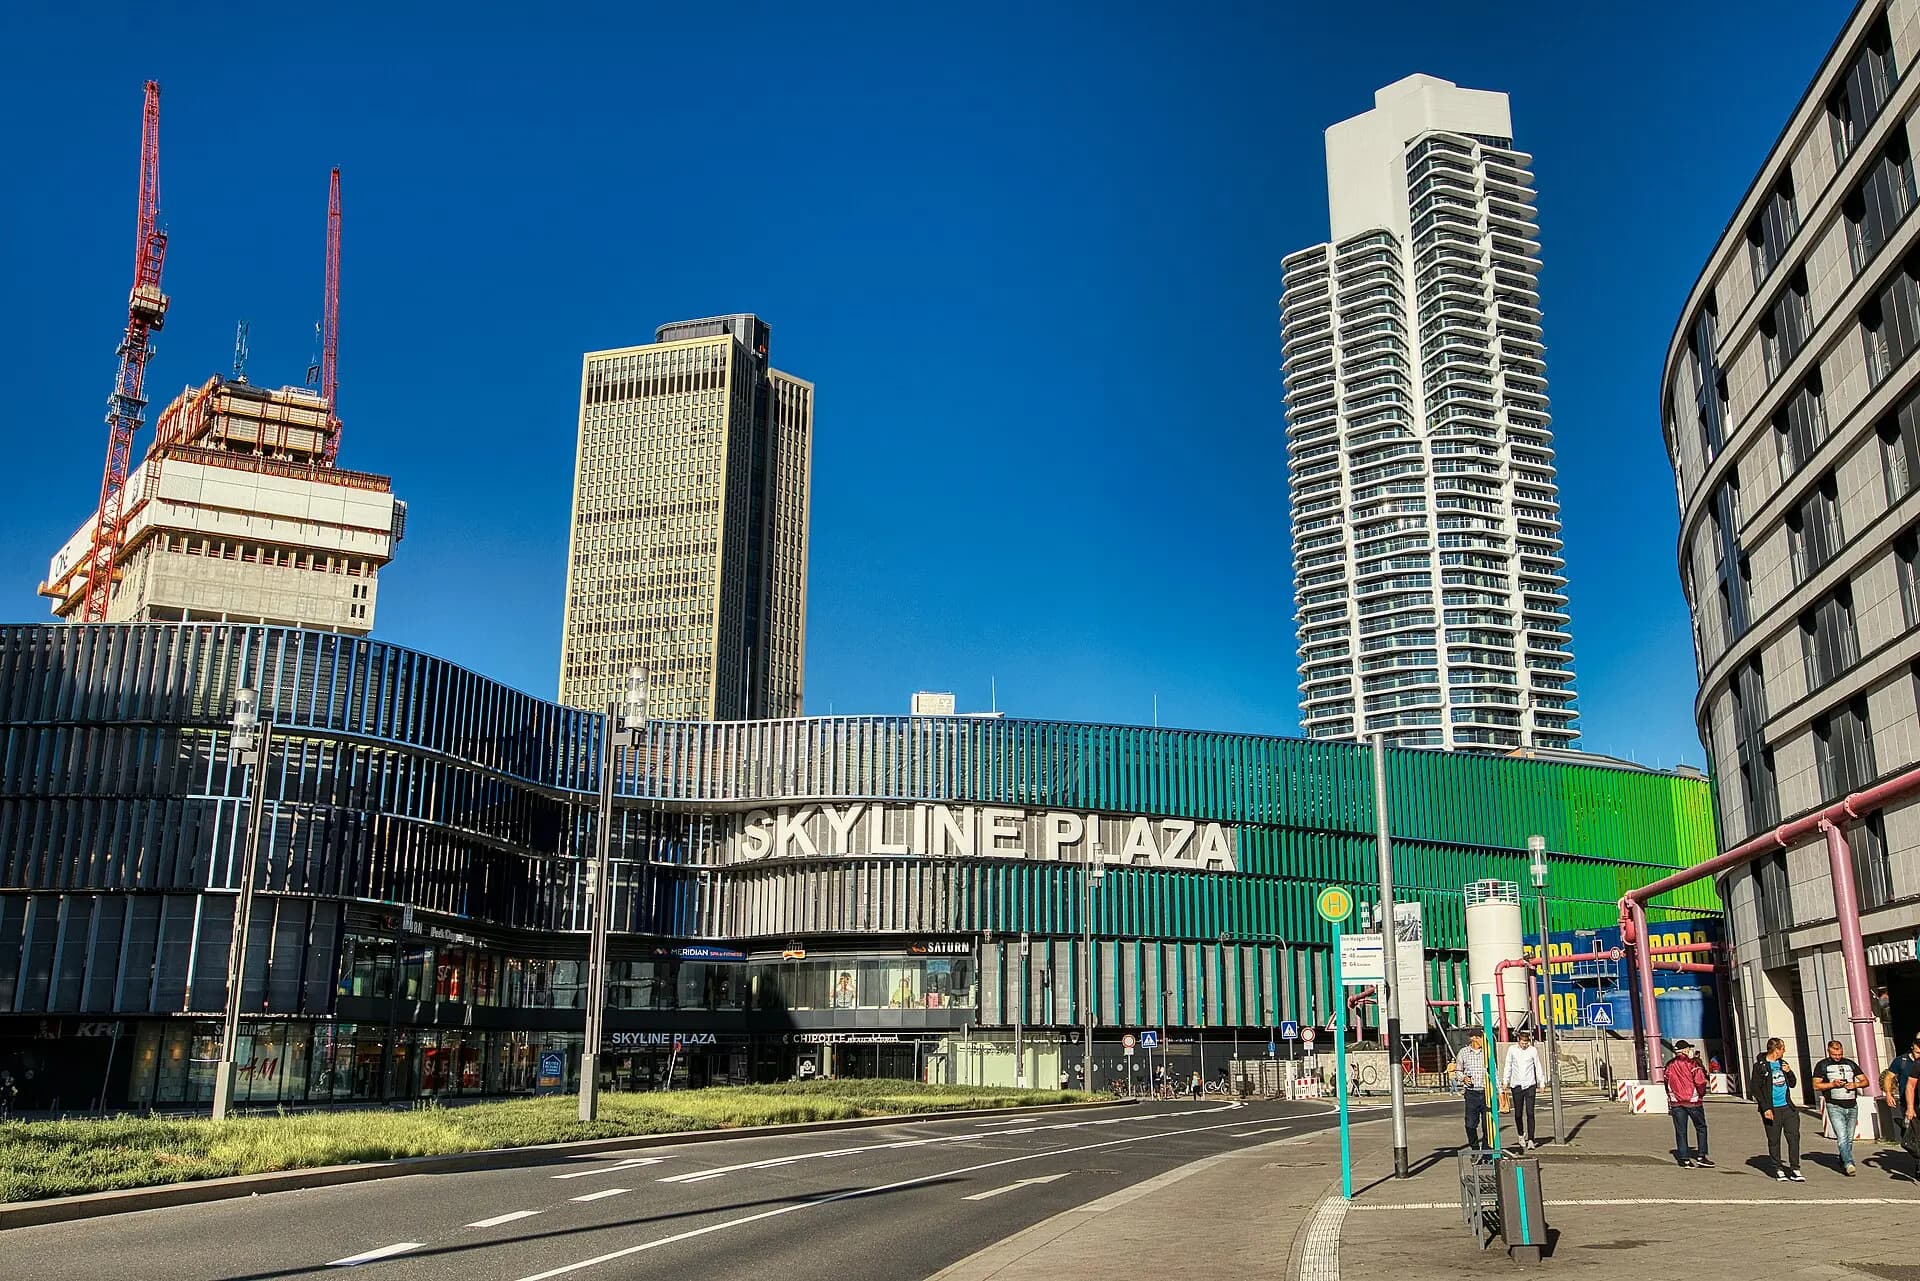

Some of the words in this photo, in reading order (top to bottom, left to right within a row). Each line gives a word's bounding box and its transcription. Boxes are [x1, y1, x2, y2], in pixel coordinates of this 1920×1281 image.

[741, 801, 1026, 859] SKYLINE
[1045, 812, 1237, 873] PLAZA
[671, 948, 709, 956] MERIDIAN
[927, 941, 970, 953] SATURN
[612, 1032, 670, 1044] SKYLINE
[674, 1033, 717, 1044] PLAZA
[793, 1033, 846, 1043] CHIPOTLE
